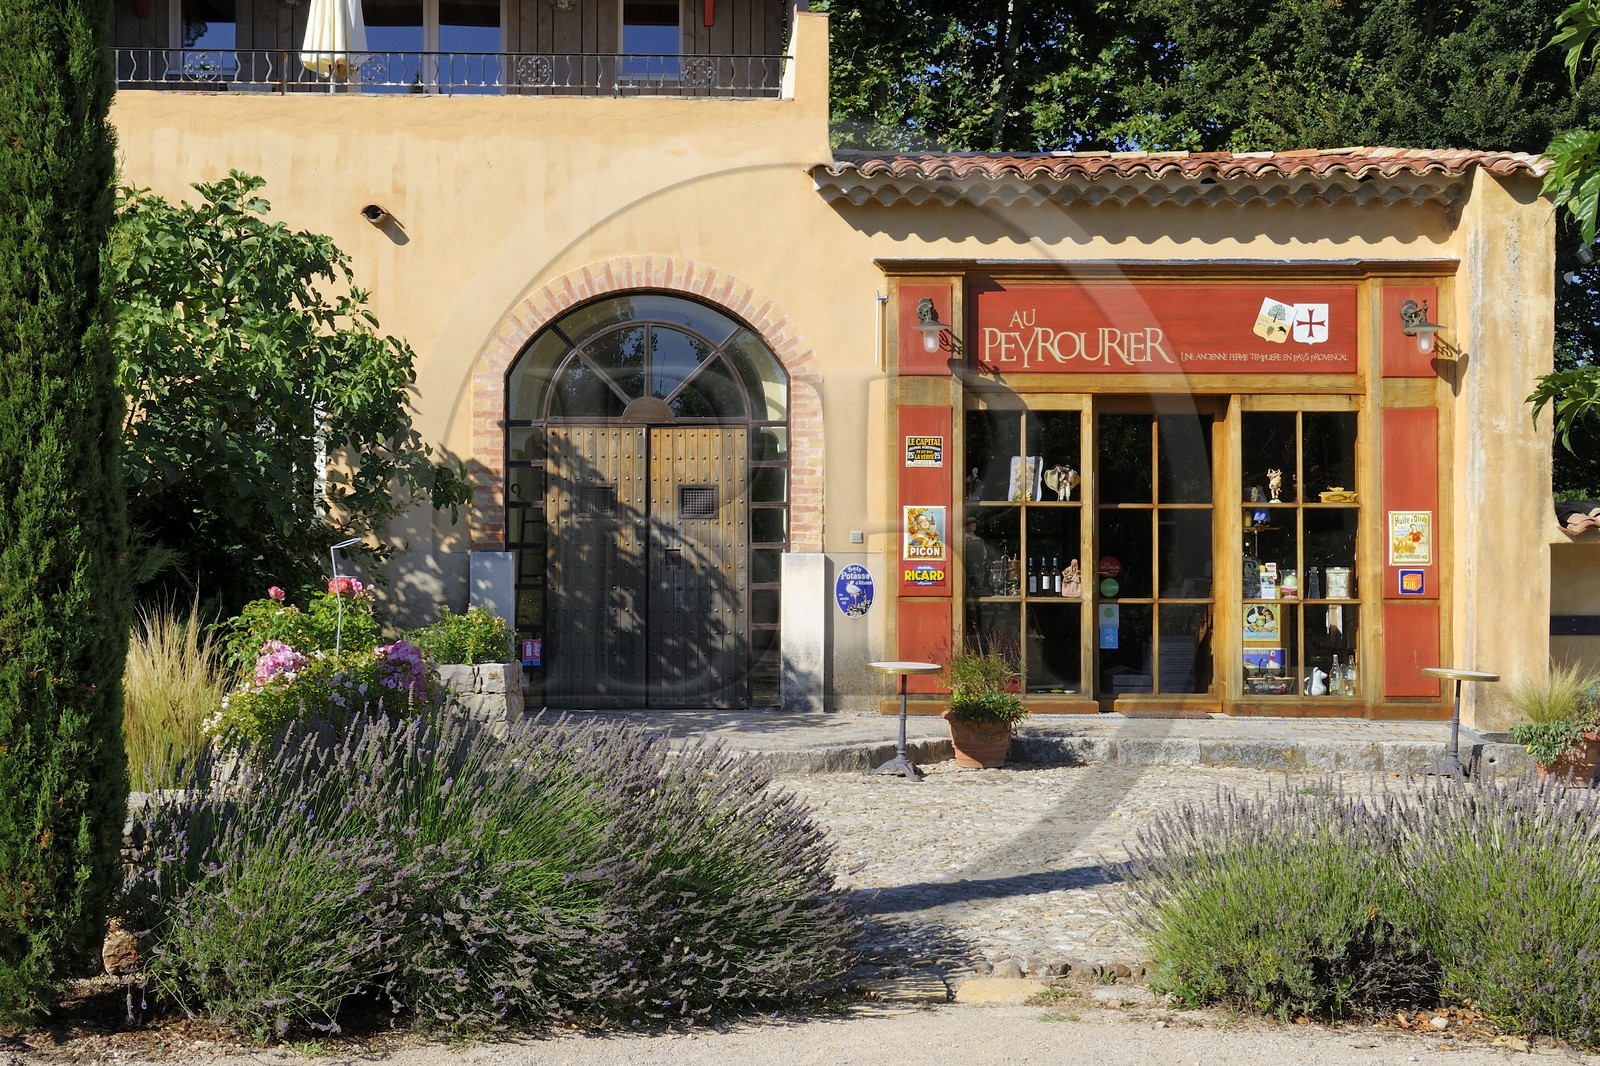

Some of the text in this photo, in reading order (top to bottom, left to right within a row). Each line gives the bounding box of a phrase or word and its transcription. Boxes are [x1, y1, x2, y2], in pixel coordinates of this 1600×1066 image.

[1009, 308, 1036, 329] AU
[982, 327, 1175, 369] PEYROURIER
[1181, 352, 1194, 362] UNE
[1196, 353, 1228, 361] ANCIENNE
[1230, 353, 1248, 362] FERME
[1283, 353, 1292, 361] EN
[908, 438, 942, 446] LE CAPITAL
[1394, 516, 1410, 526] Huile
[910, 547, 940, 556] PICON
[840, 572, 870, 580] Potasse
[904, 570, 945, 581] RICARD
[1403, 580, 1416, 589] KUB
